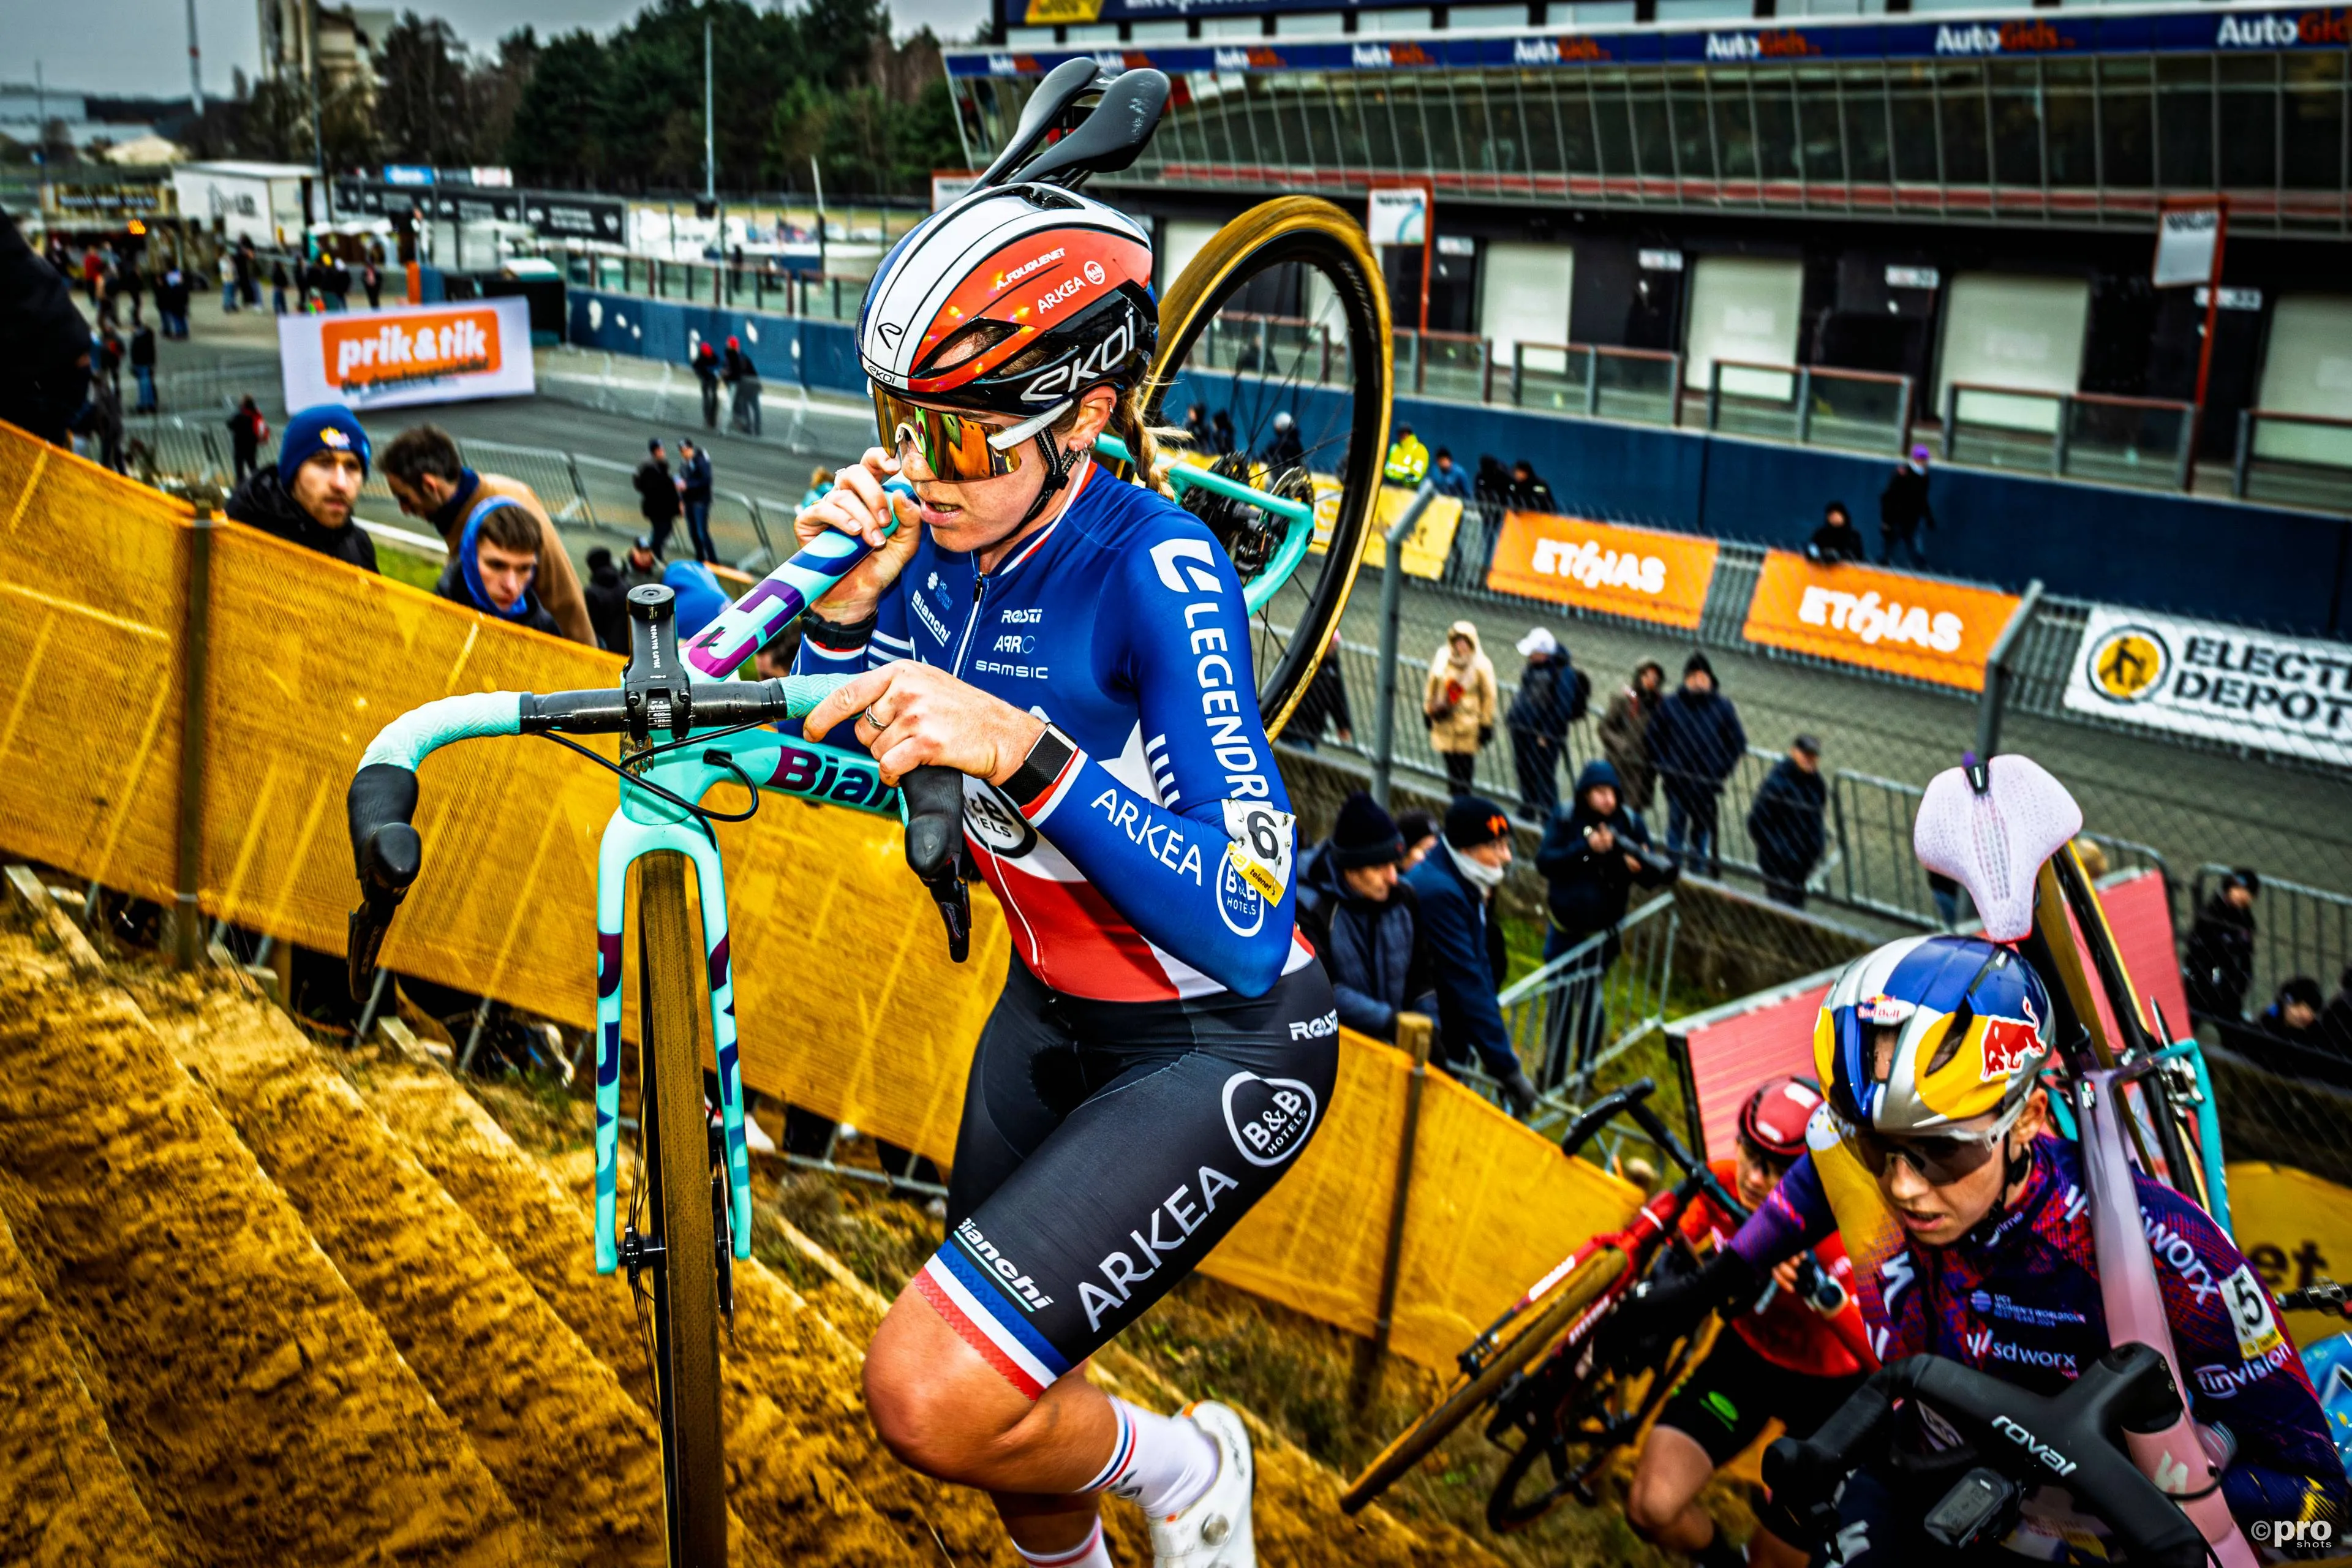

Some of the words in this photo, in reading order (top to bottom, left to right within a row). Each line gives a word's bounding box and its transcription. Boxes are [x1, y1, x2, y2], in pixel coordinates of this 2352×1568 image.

[1038, 276, 1087, 314] ARKEA
[337, 319, 487, 377] prik&tik
[912, 589, 951, 642] Bianchi
[975, 660, 1049, 679] SAMSIC
[2184, 636, 2352, 692] ELECT
[1184, 602, 1275, 810] LEGENDR
[2173, 669, 2352, 728] DEPOT
[765, 745, 900, 813] Bian
[1090, 788, 1202, 887] ARKEA
[1247, 810, 1279, 860] 6
[1250, 869, 1272, 891] telenet
[1242, 1091, 1301, 1152] B&B
[1267, 1109, 1307, 1155] HOTELS
[1078, 1166, 1239, 1332] ARKEA
[2140, 1205, 2220, 1305] worx
[2228, 1272, 2264, 1328] 5
[1991, 1415, 2077, 1477] roval
